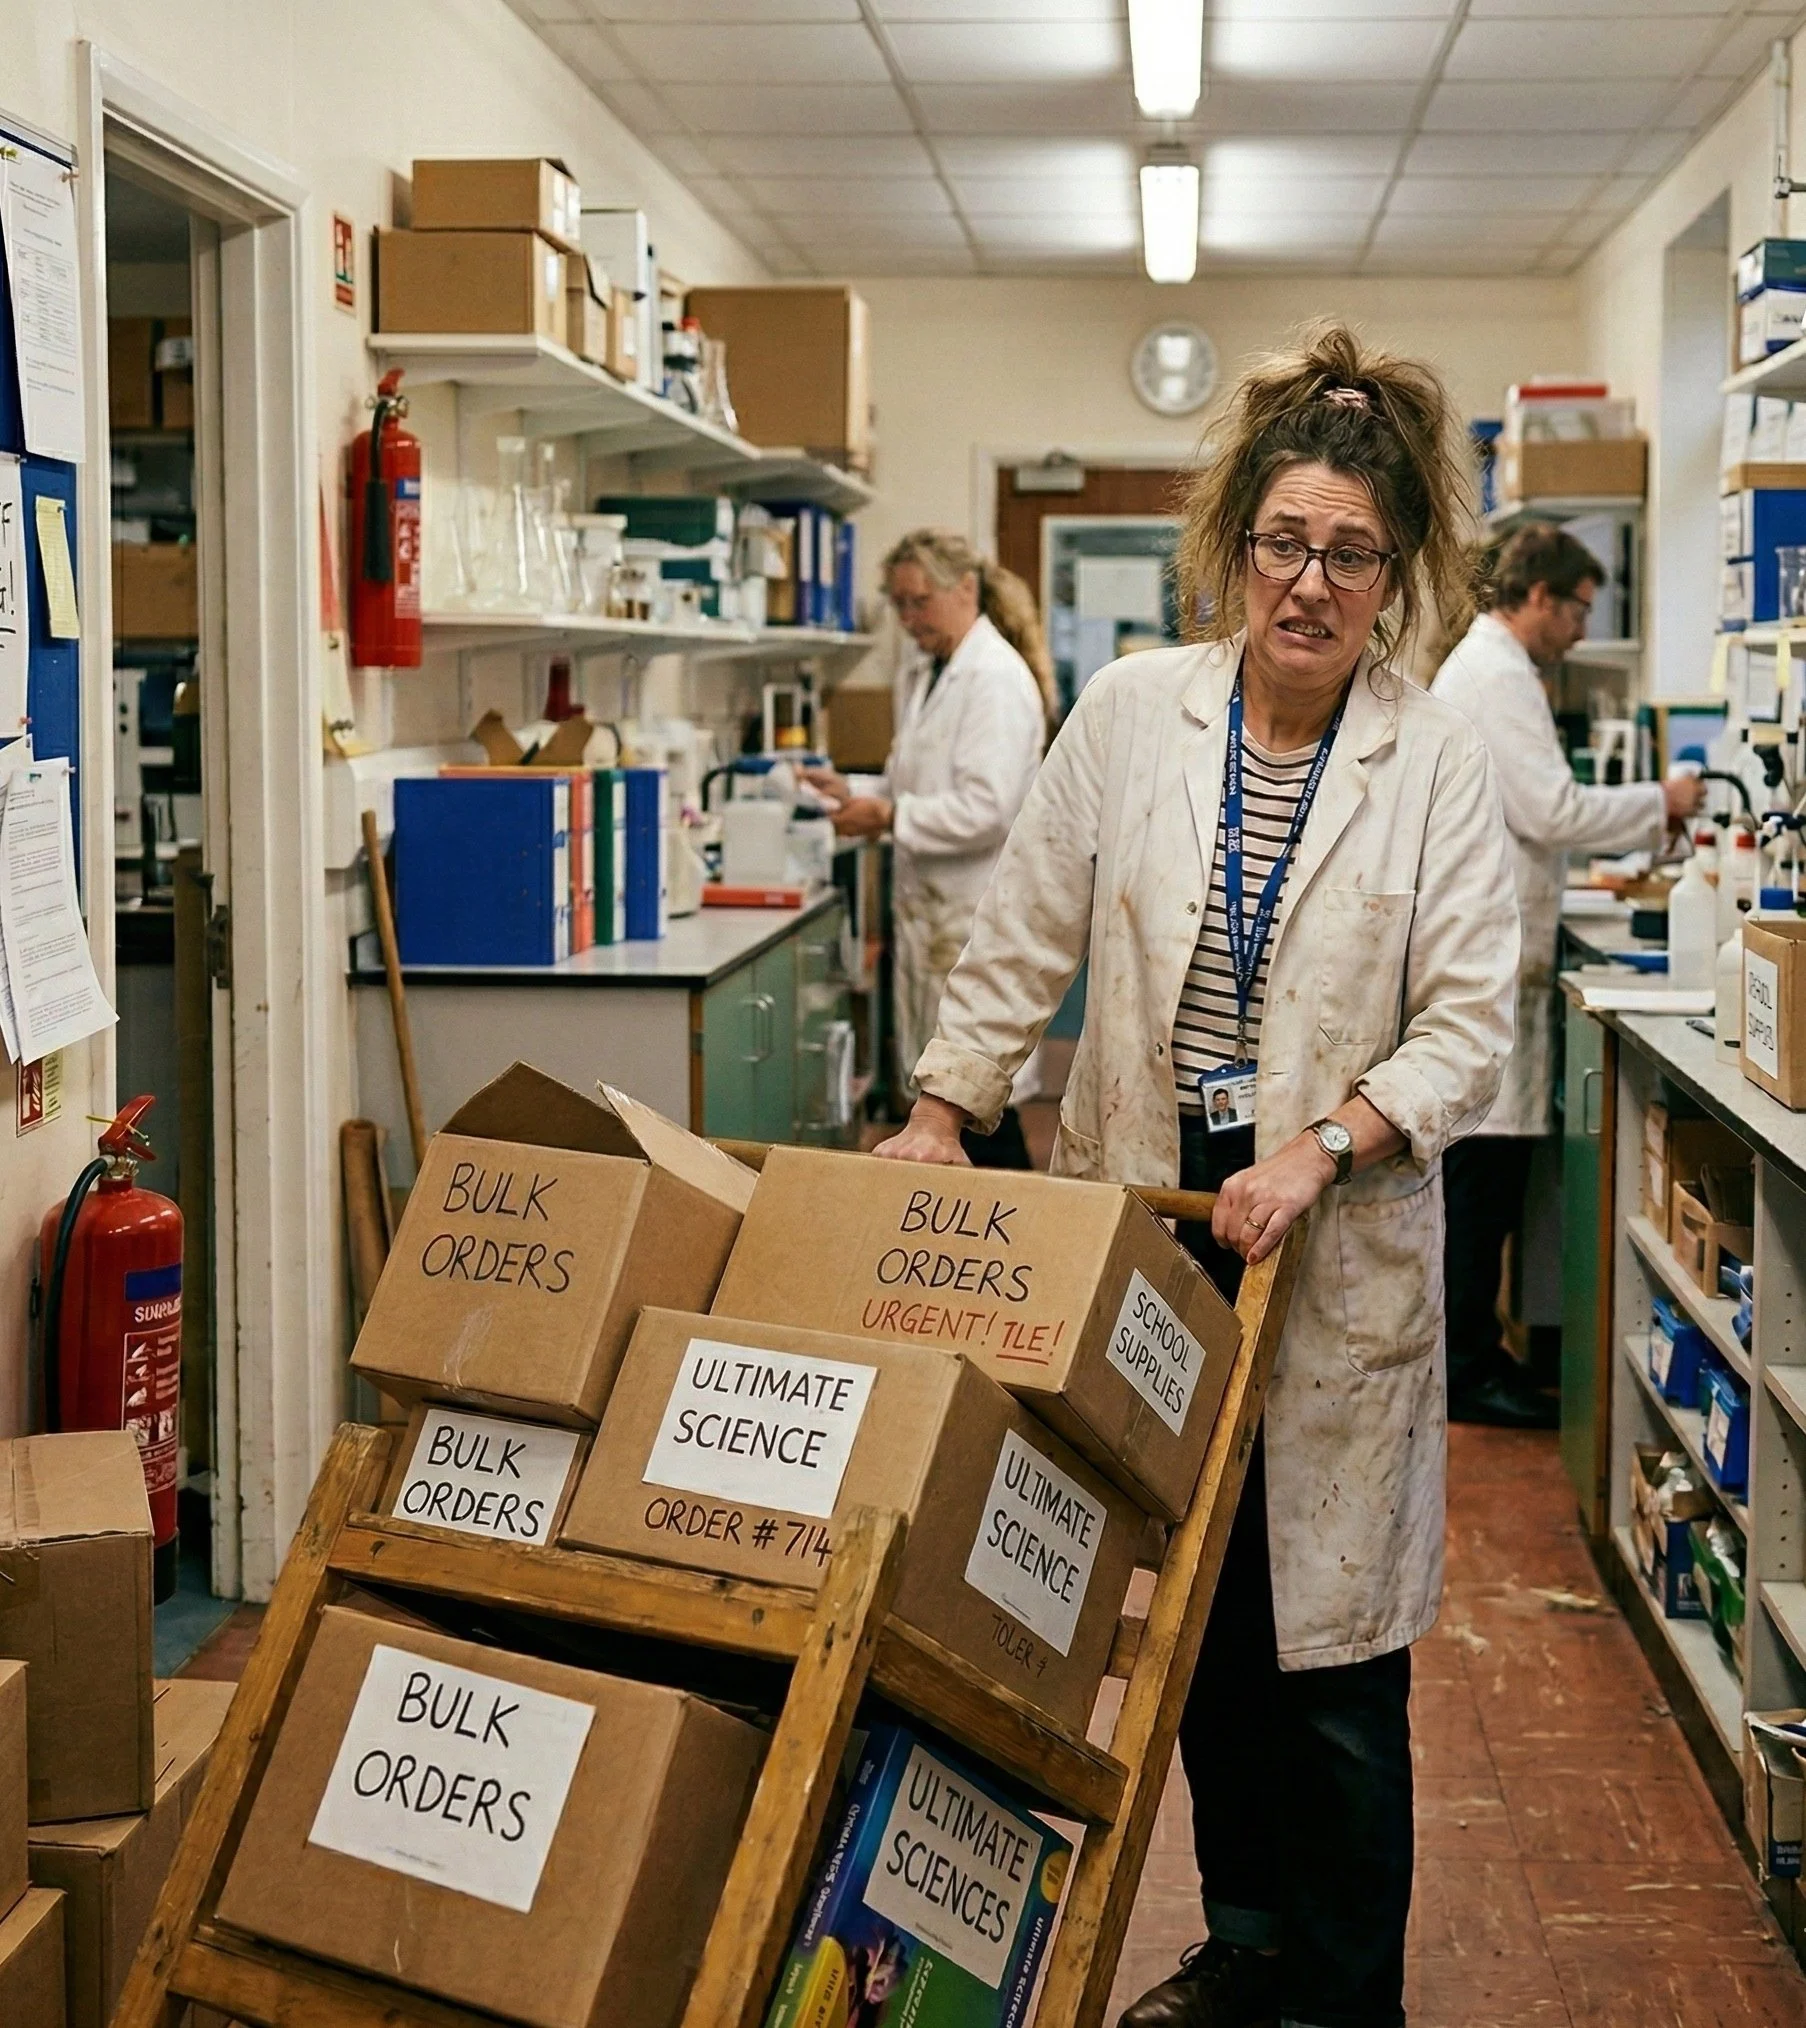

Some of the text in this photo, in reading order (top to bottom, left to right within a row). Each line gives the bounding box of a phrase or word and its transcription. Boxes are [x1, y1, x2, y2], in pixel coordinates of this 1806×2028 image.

[443, 1161, 558, 1222] BULK
[900, 1190, 1018, 1245] BULK
[421, 1233, 575, 1294] ORDERS
[876, 1248, 1034, 1303] ORDERS
[861, 1298, 999, 1346] URGENT!
[1131, 1291, 1190, 1373] SCHOOL
[691, 1357, 855, 1412] ULTIMATE
[1114, 1325, 1186, 1414] SUPPLIES
[427, 1425, 527, 1479] BULK
[673, 1409, 828, 1469] SCIENCE
[402, 1480, 545, 1538] ORDERS
[644, 1497, 743, 1545] ORDER
[1003, 1449, 1096, 1550] ULTIMATE
[986, 1508, 1081, 1605] SCIENCE
[396, 1670, 520, 1749] BULK
[353, 1749, 532, 1842] ORDERS
[908, 1763, 1030, 1883] ULTIMATE
[886, 1829, 1011, 1944] SCIENCES
